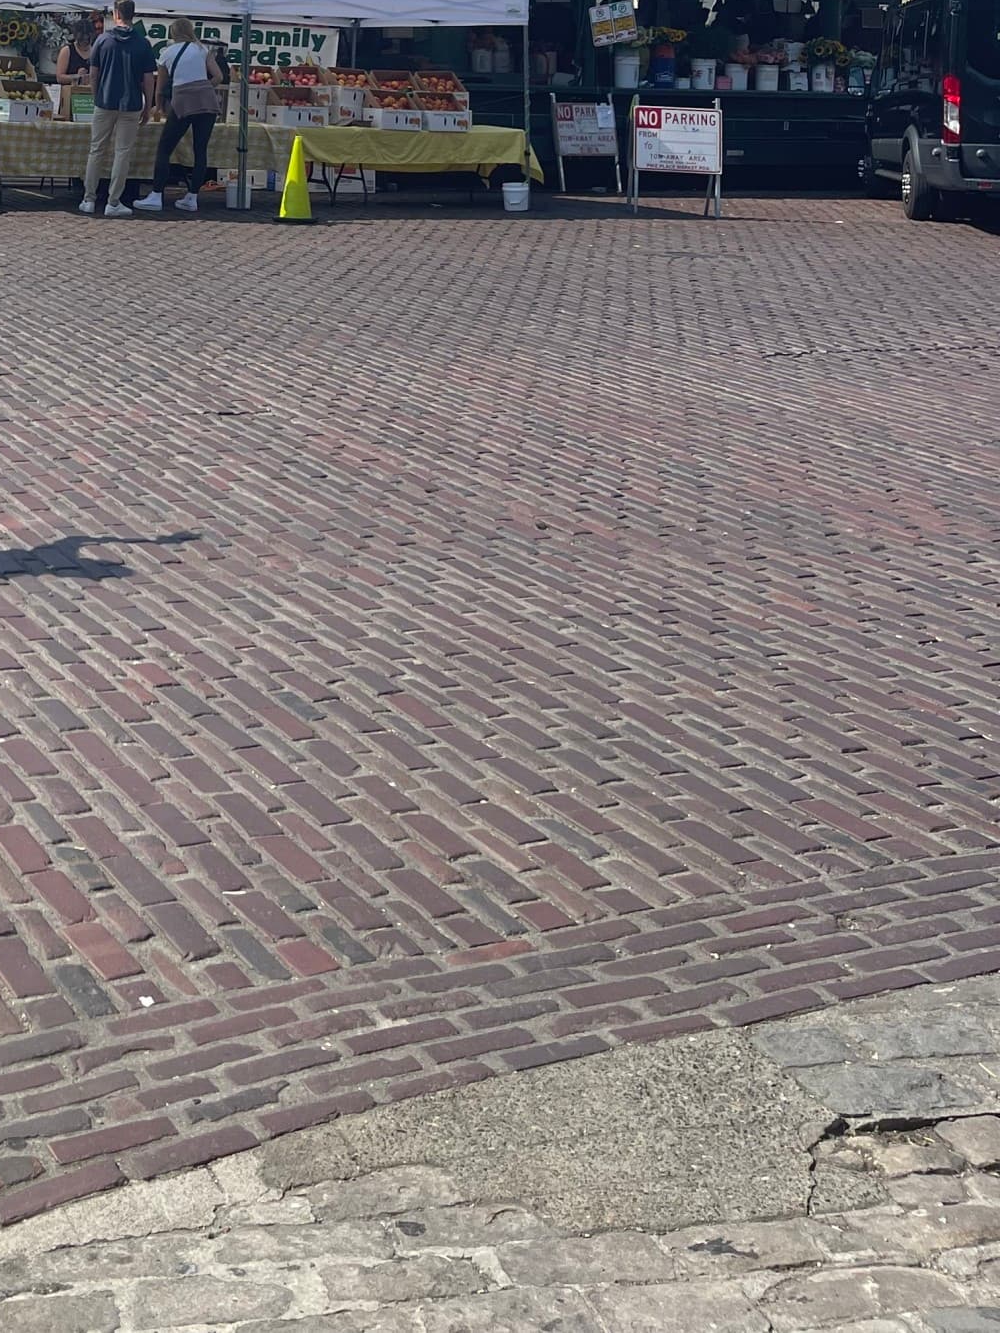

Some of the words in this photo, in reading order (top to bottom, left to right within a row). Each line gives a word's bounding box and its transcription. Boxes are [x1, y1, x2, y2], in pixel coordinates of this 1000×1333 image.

[230, 24, 327, 53] Family
[557, 106, 571, 119] NO
[638, 110, 659, 126] NO
[664, 112, 717, 127] PARKING
[638, 130, 658, 139] FROM
